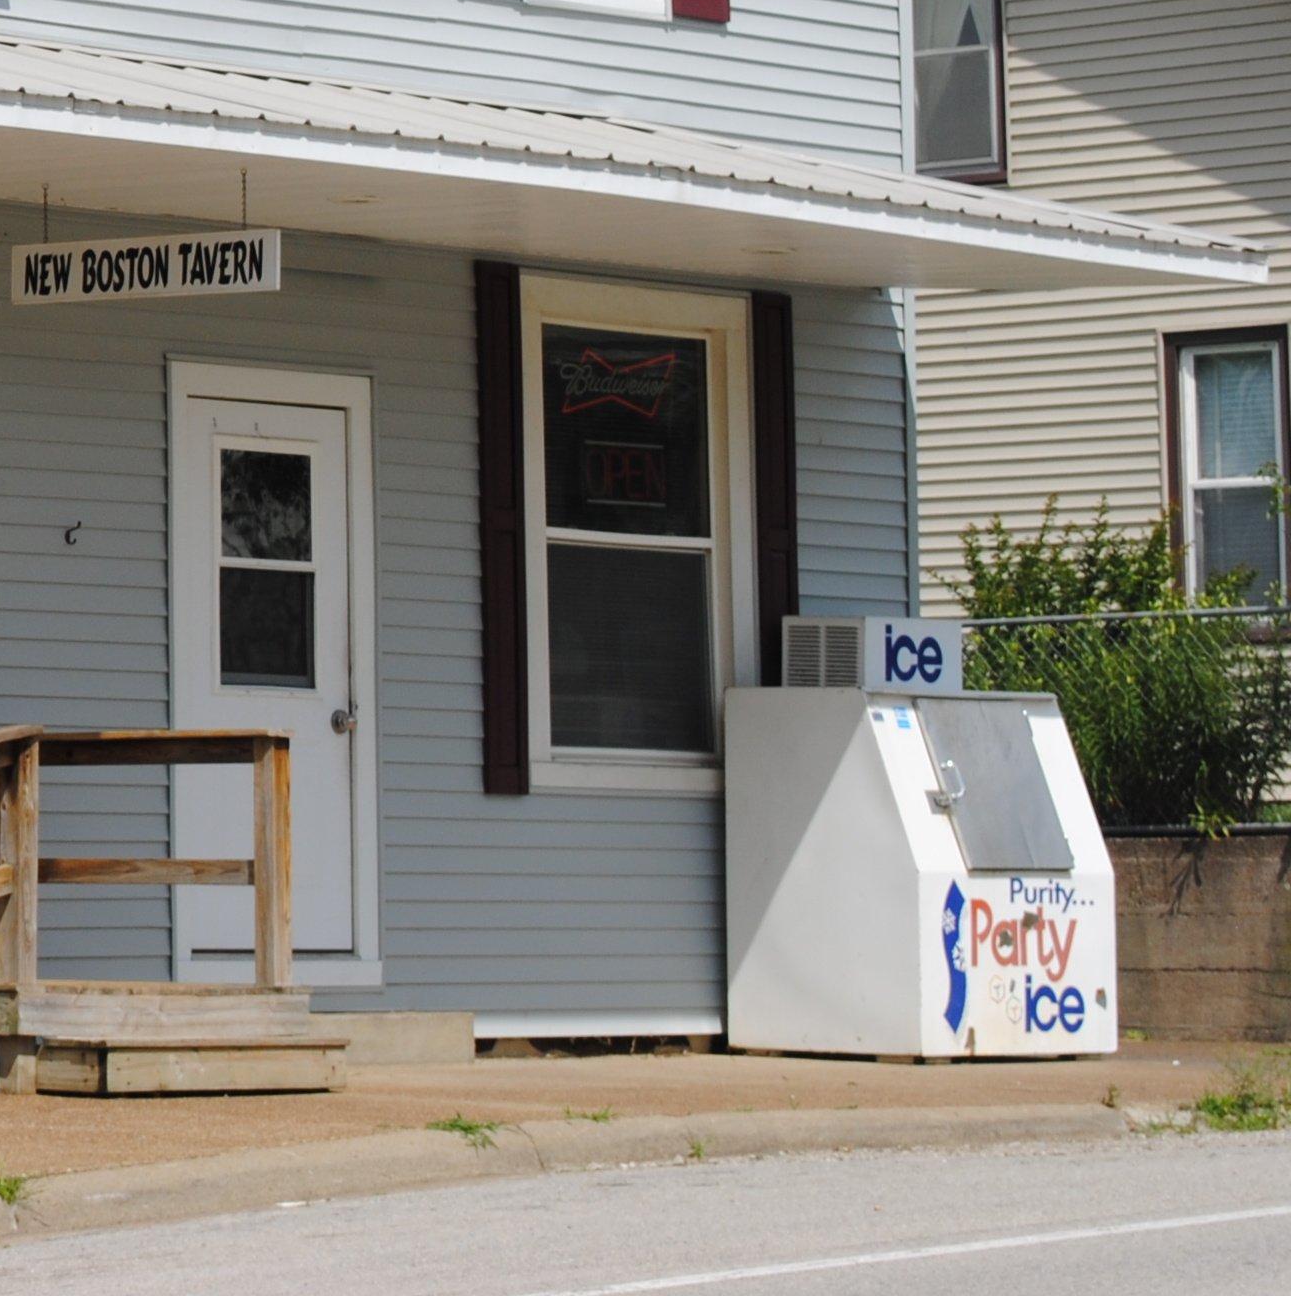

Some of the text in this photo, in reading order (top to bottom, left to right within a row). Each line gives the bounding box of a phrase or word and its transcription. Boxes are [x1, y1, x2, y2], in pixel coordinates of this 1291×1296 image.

[24, 238, 263, 296] NEW BOSTON TAVERN
[560, 362, 668, 396] Budweiser
[587, 447, 667, 500] OPEN
[884, 624, 943, 683] ice
[970, 898, 1077, 983] Party
[1025, 974, 1085, 1034] ice
